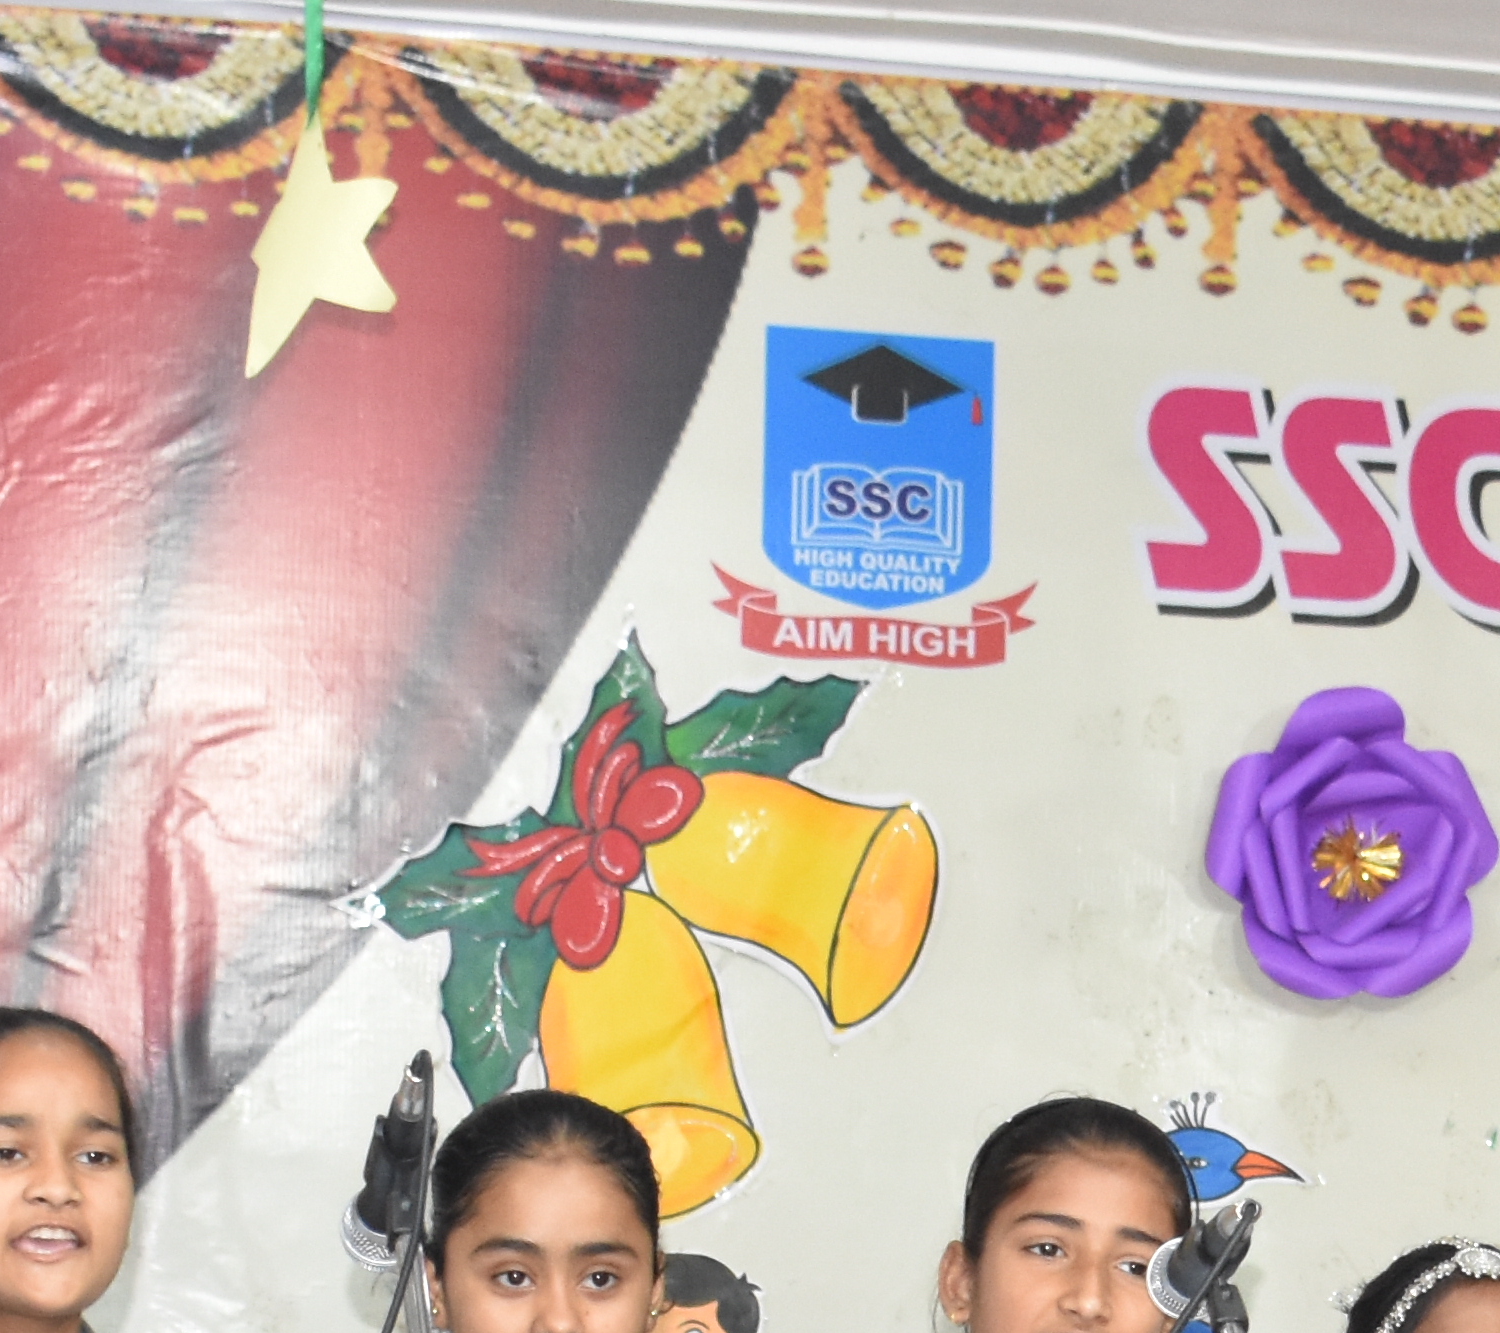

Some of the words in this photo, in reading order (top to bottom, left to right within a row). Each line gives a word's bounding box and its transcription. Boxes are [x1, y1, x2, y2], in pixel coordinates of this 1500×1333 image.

[824, 477, 932, 524] SSC
[792, 549, 853, 568] HIGH
[859, 552, 962, 576] QUALITY
[809, 569, 946, 595] EDUCATION
[772, 617, 854, 651] AIM
[868, 621, 977, 660] HIGH
